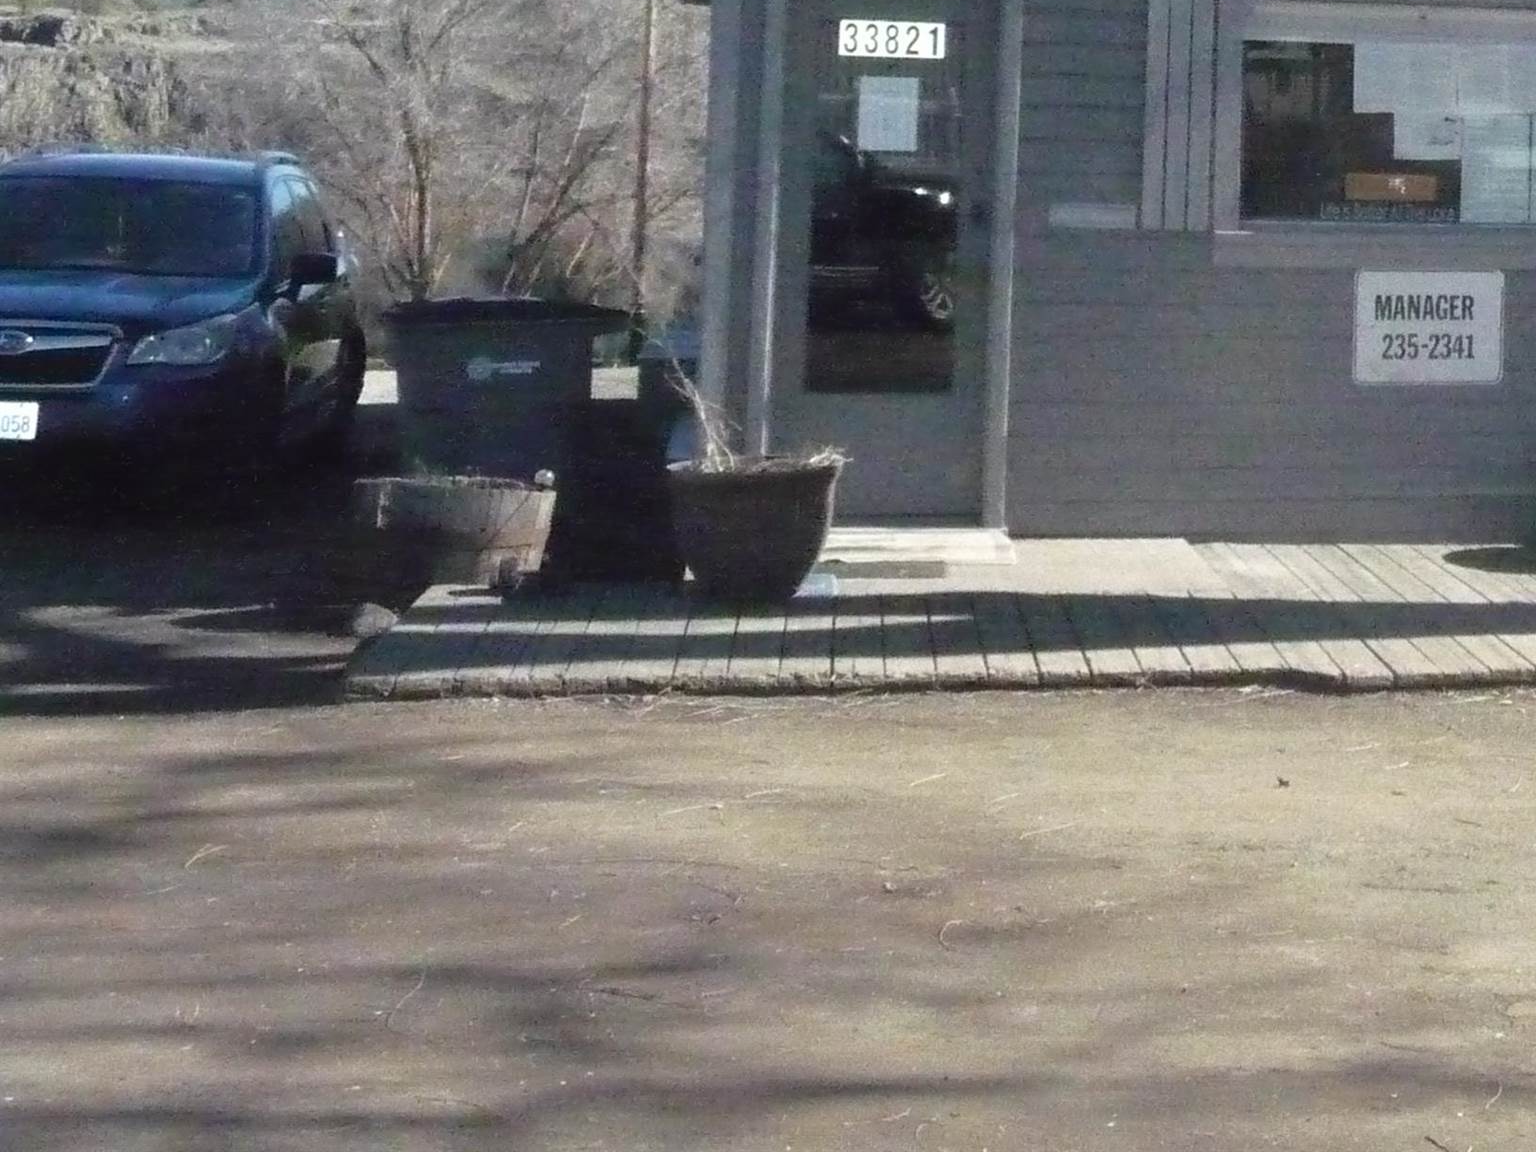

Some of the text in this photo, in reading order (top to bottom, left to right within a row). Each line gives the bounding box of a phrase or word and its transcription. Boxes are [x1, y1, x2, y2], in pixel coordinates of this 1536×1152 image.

[844, 23, 939, 56] 33821
[1375, 294, 1475, 321] MANAGER
[1382, 333, 1475, 360] 235-2341
